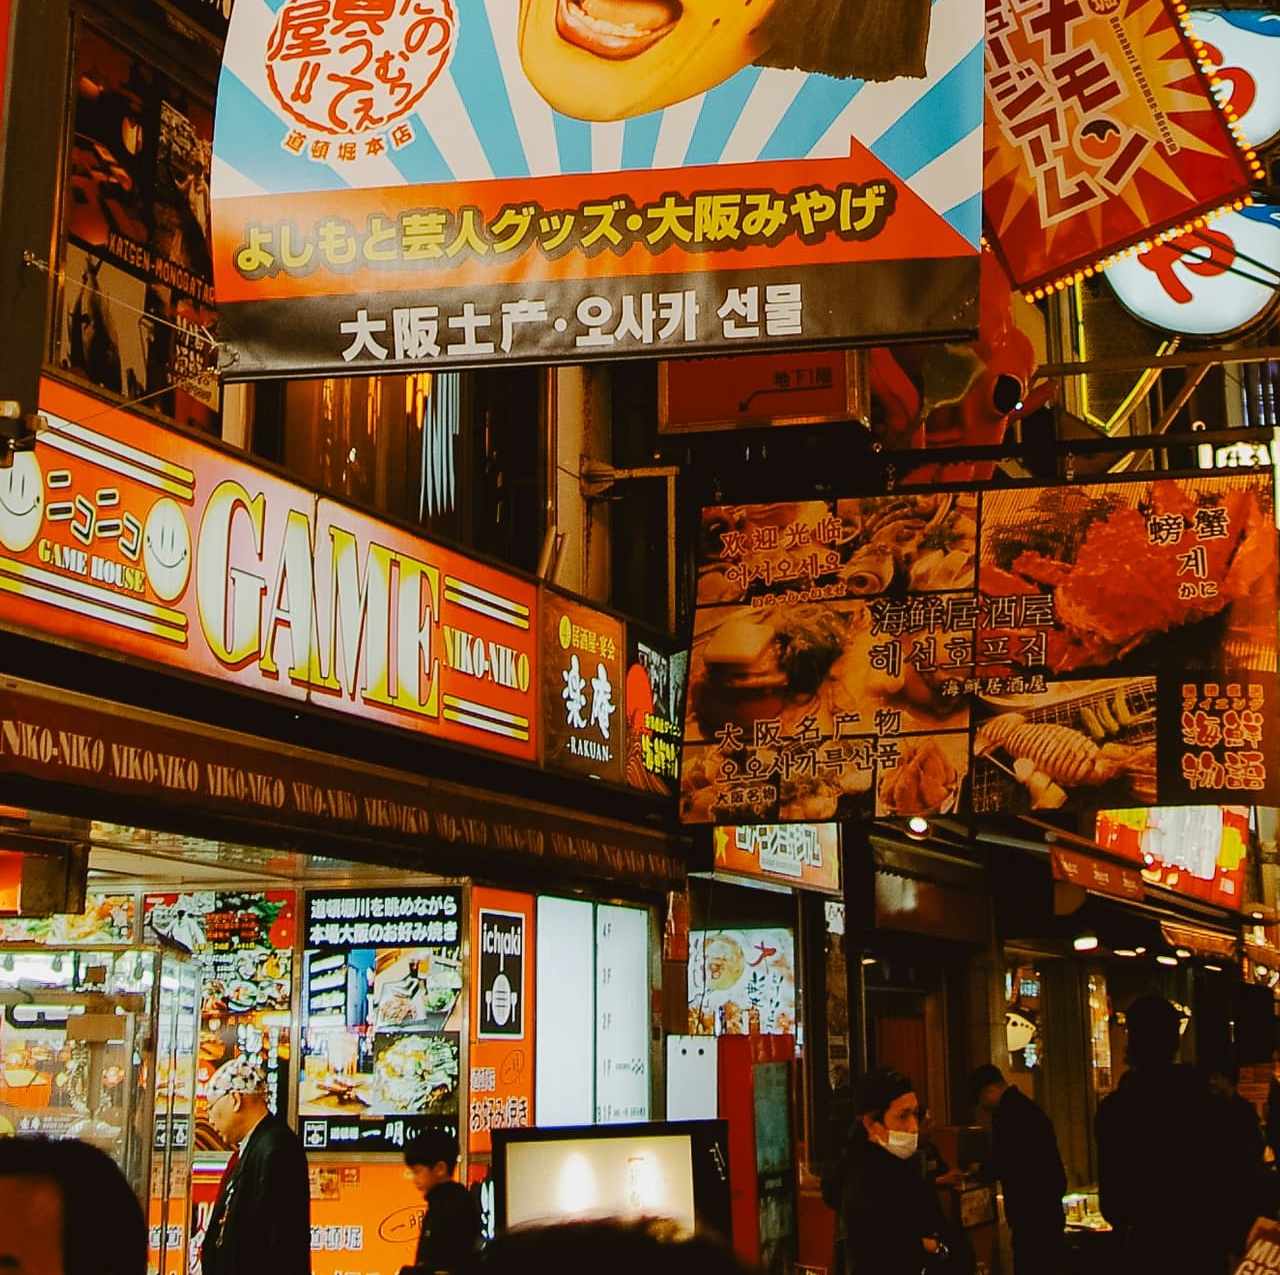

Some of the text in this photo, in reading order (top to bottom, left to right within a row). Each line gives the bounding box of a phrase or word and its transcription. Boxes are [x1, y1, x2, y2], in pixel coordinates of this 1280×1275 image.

[283, 125, 414, 162] 道頓堀本店
[235, 183, 889, 275] よしもと芸人グッズ・大阪みやげ
[717, 283, 805, 337] 선물
[46, 470, 143, 561] ニコニコ
[720, 518, 844, 559] 欢迎光临
[37, 538, 146, 594] GAME HOUSE
[726, 552, 845, 589] 어서오세요
[194, 479, 441, 719] GAME
[1178, 581, 1219, 601] かに
[871, 594, 1056, 637] 海鮮居酒屋
[443, 625, 530, 693] NIKO-NIKO
[870, 632, 1049, 677] 해선호프집
[941, 674, 1050, 699] 海鮮居酒屋
[715, 708, 902, 753] 大阪名产物
[0, 719, 105, 773] NIKO-NIKO
[110, 742, 200, 793] NIKO-NIKO
[206, 762, 286, 810] NIKO-NIKO
[715, 785, 778, 808] 大阪名物
[309, 921, 459, 945] 本場大阪のお好み焼き
